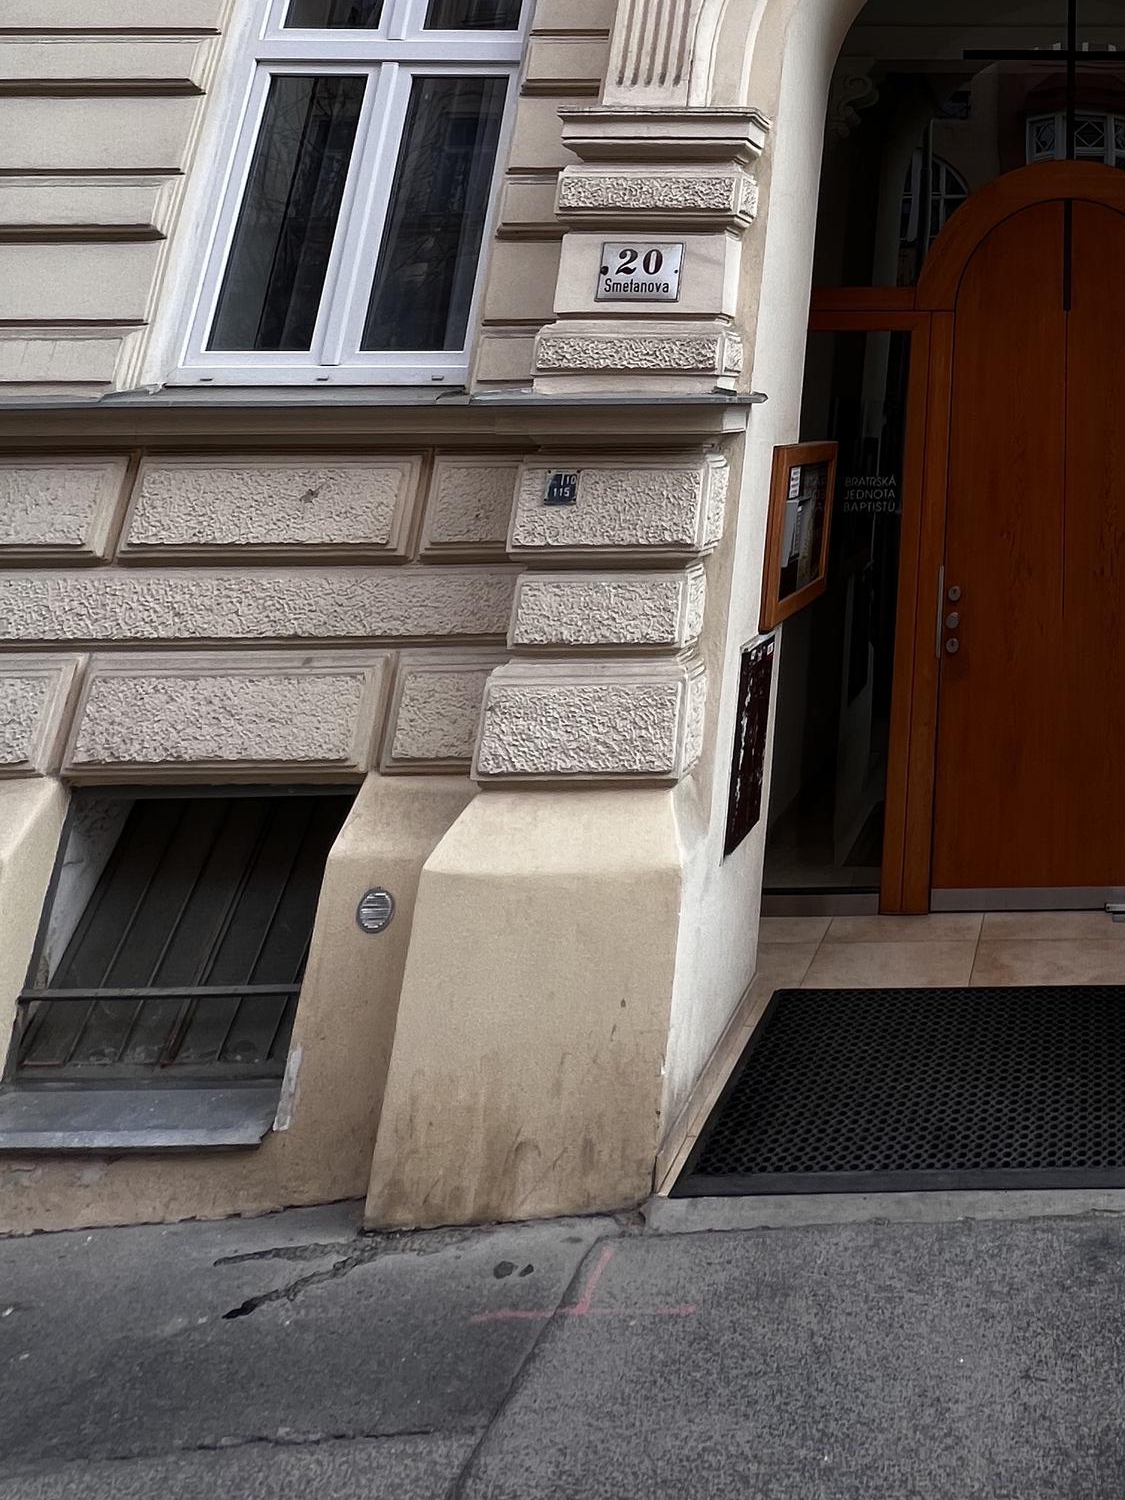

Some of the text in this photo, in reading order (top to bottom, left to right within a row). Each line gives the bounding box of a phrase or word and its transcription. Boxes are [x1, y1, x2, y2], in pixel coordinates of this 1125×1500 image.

[615, 249, 663, 275] 20
[604, 278, 669, 293] Smetanova
[845, 474, 897, 487] BRATRSKÁ
[553, 486, 570, 497] 115
[844, 489, 896, 500] JEDNOTA
